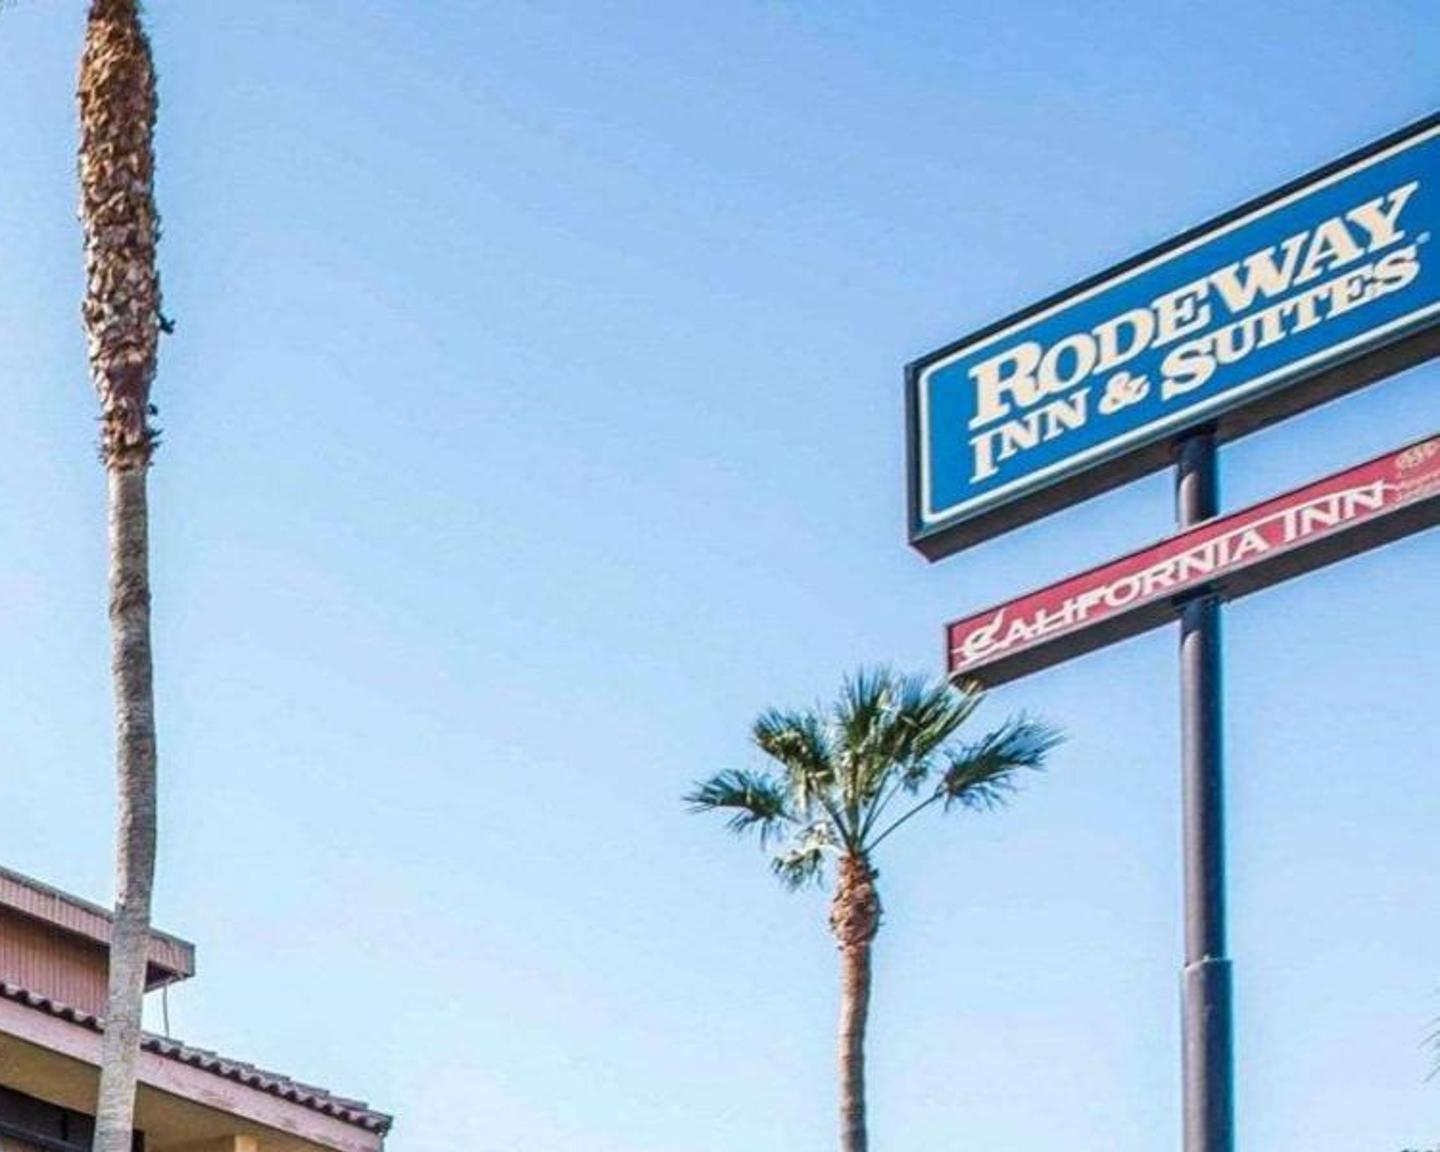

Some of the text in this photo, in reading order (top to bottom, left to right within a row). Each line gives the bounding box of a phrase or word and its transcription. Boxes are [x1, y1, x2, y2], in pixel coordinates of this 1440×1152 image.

[968, 180, 1420, 431] RODEWAY
[968, 243, 1421, 484] INN & SUITES
[952, 479, 1386, 667] CALIFORNIA INN
